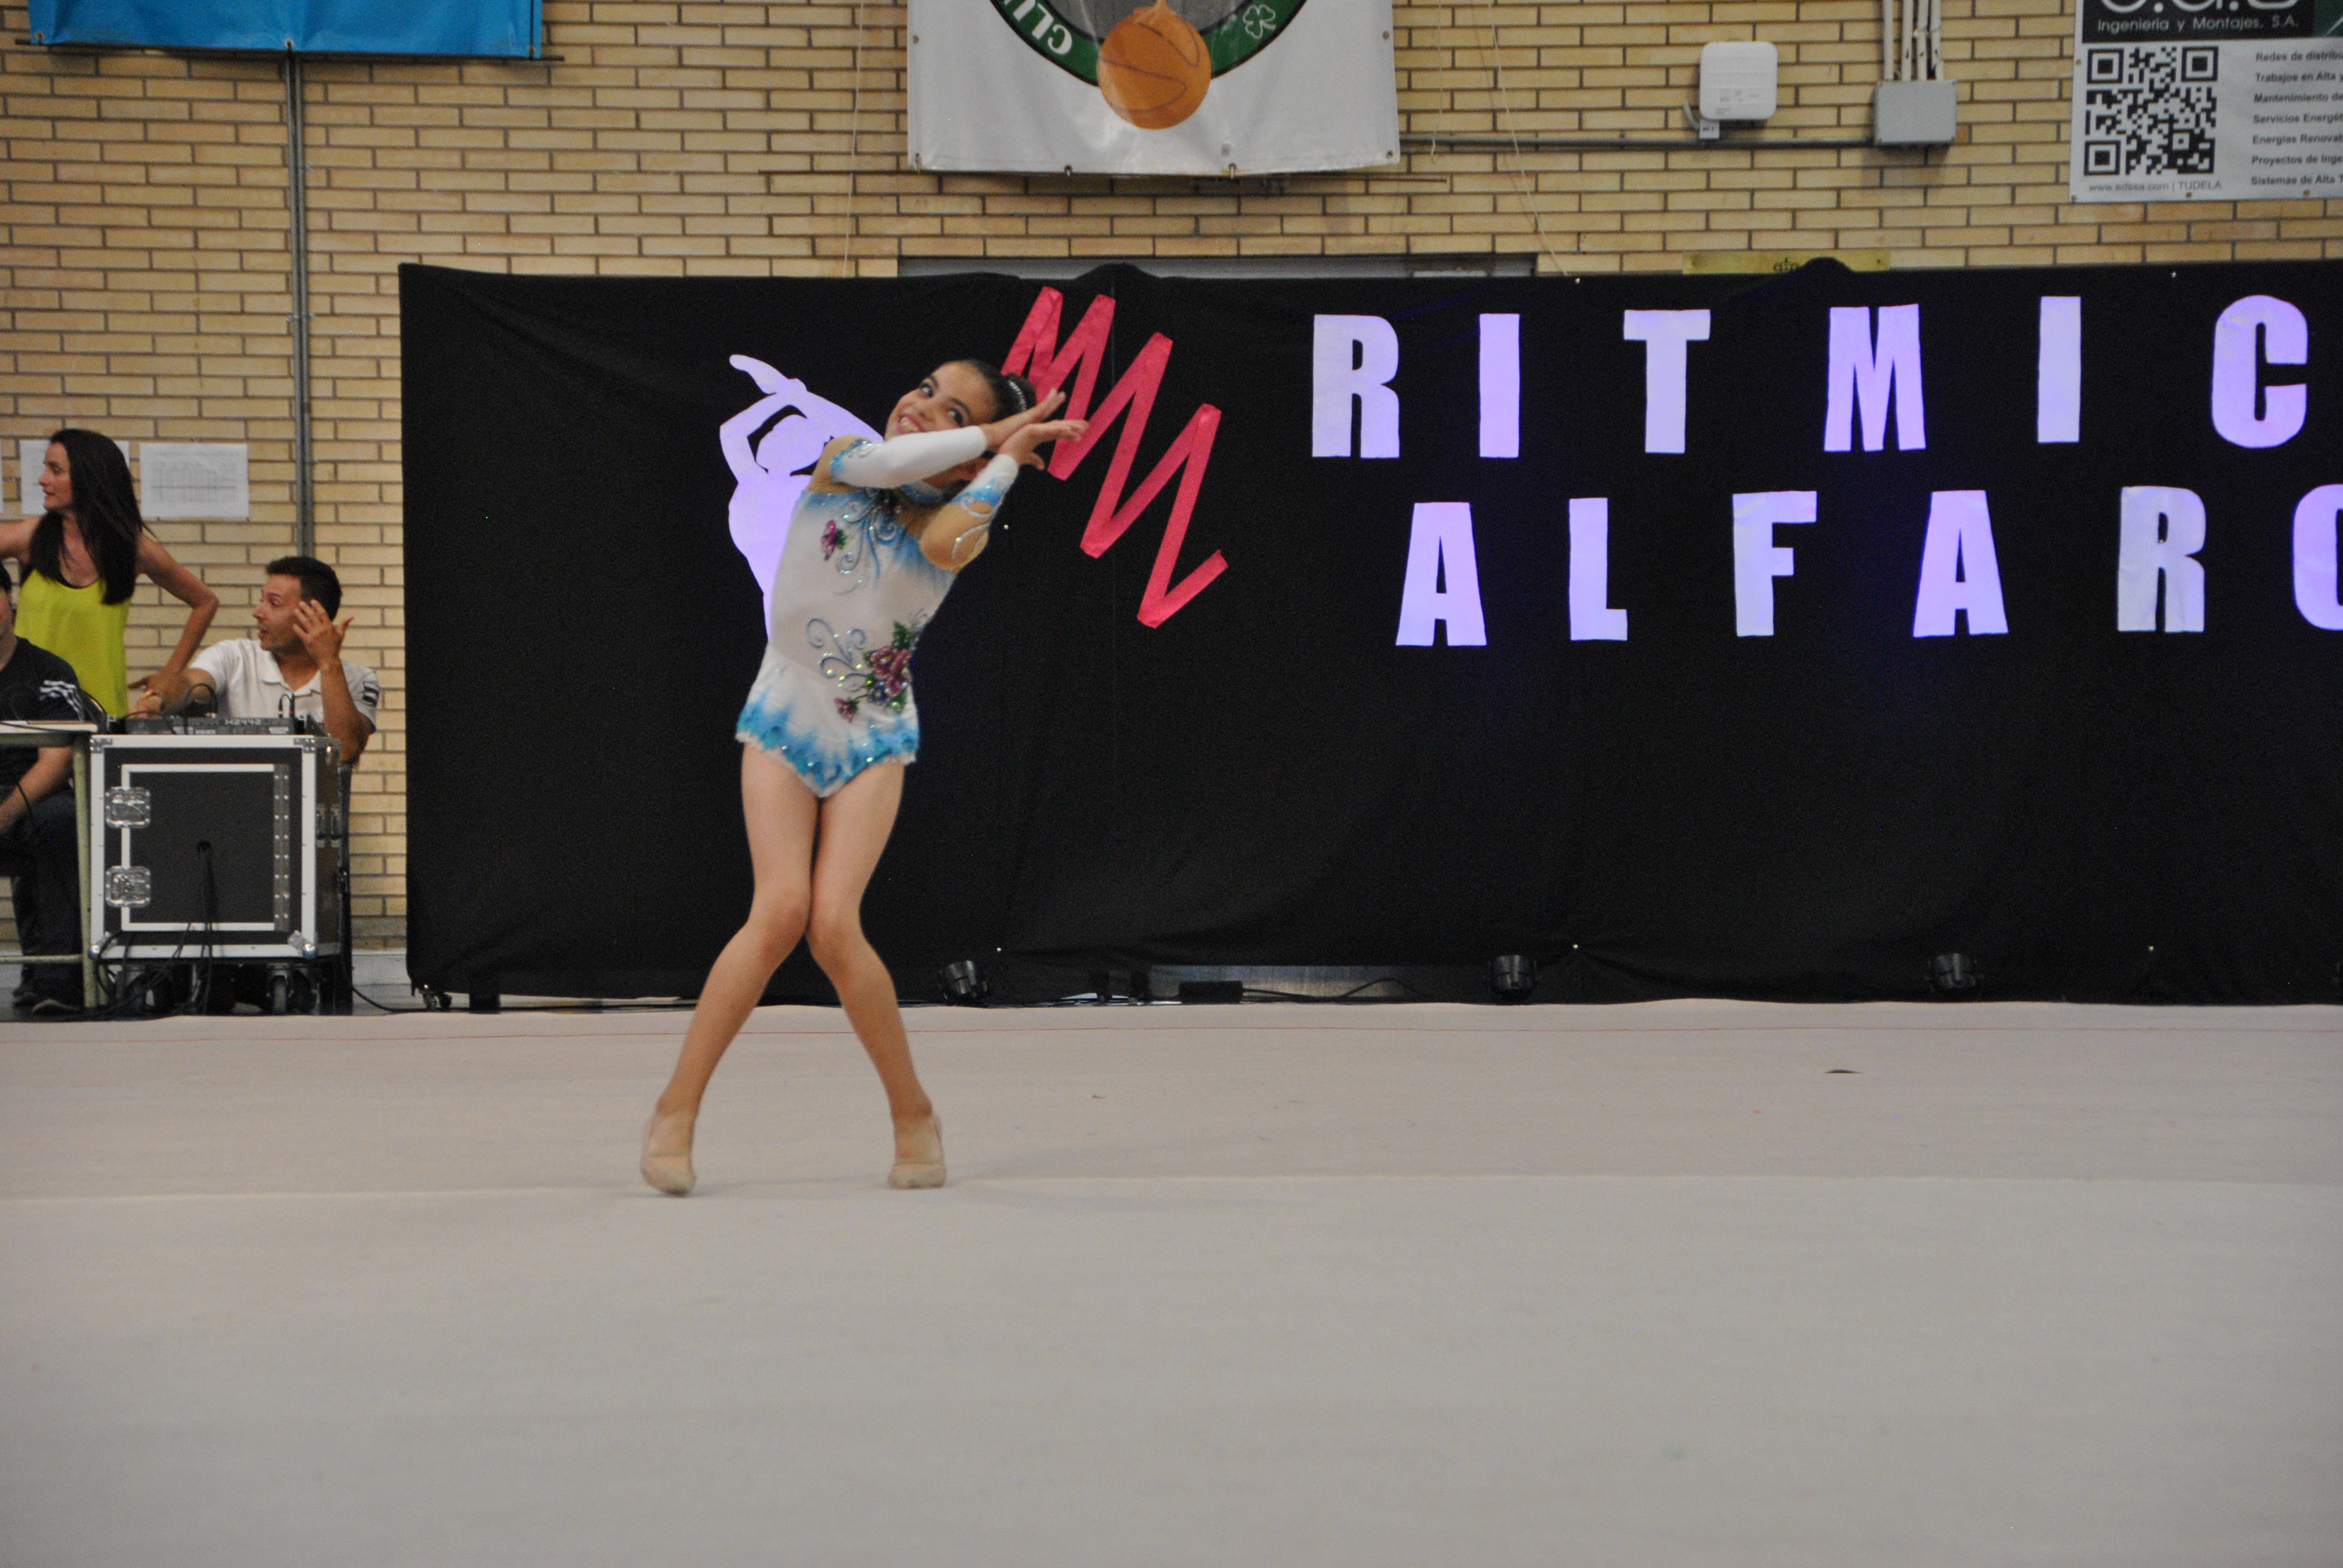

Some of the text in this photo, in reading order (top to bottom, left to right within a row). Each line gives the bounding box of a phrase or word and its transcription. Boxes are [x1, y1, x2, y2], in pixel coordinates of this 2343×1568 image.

[2178, 19, 2186, 33] y
[2256, 51, 2288, 61] Redes
[2290, 51, 2303, 60] de
[2256, 72, 2298, 83] Trabajos
[2301, 73, 2313, 82] en
[2316, 71, 2336, 82] Alta
[2253, 93, 2329, 103] Mantenimiento
[2253, 114, 2300, 123] Servicios
[2251, 155, 2303, 168] Proyectos
[2305, 154, 2318, 165] de
[2179, 180, 2222, 191] TUDELA
[2250, 175, 2298, 186] Sistemas
[2300, 174, 2313, 185] de
[2315, 174, 2336, 184] Alta
[1311, 295, 2309, 459] RITMIC
